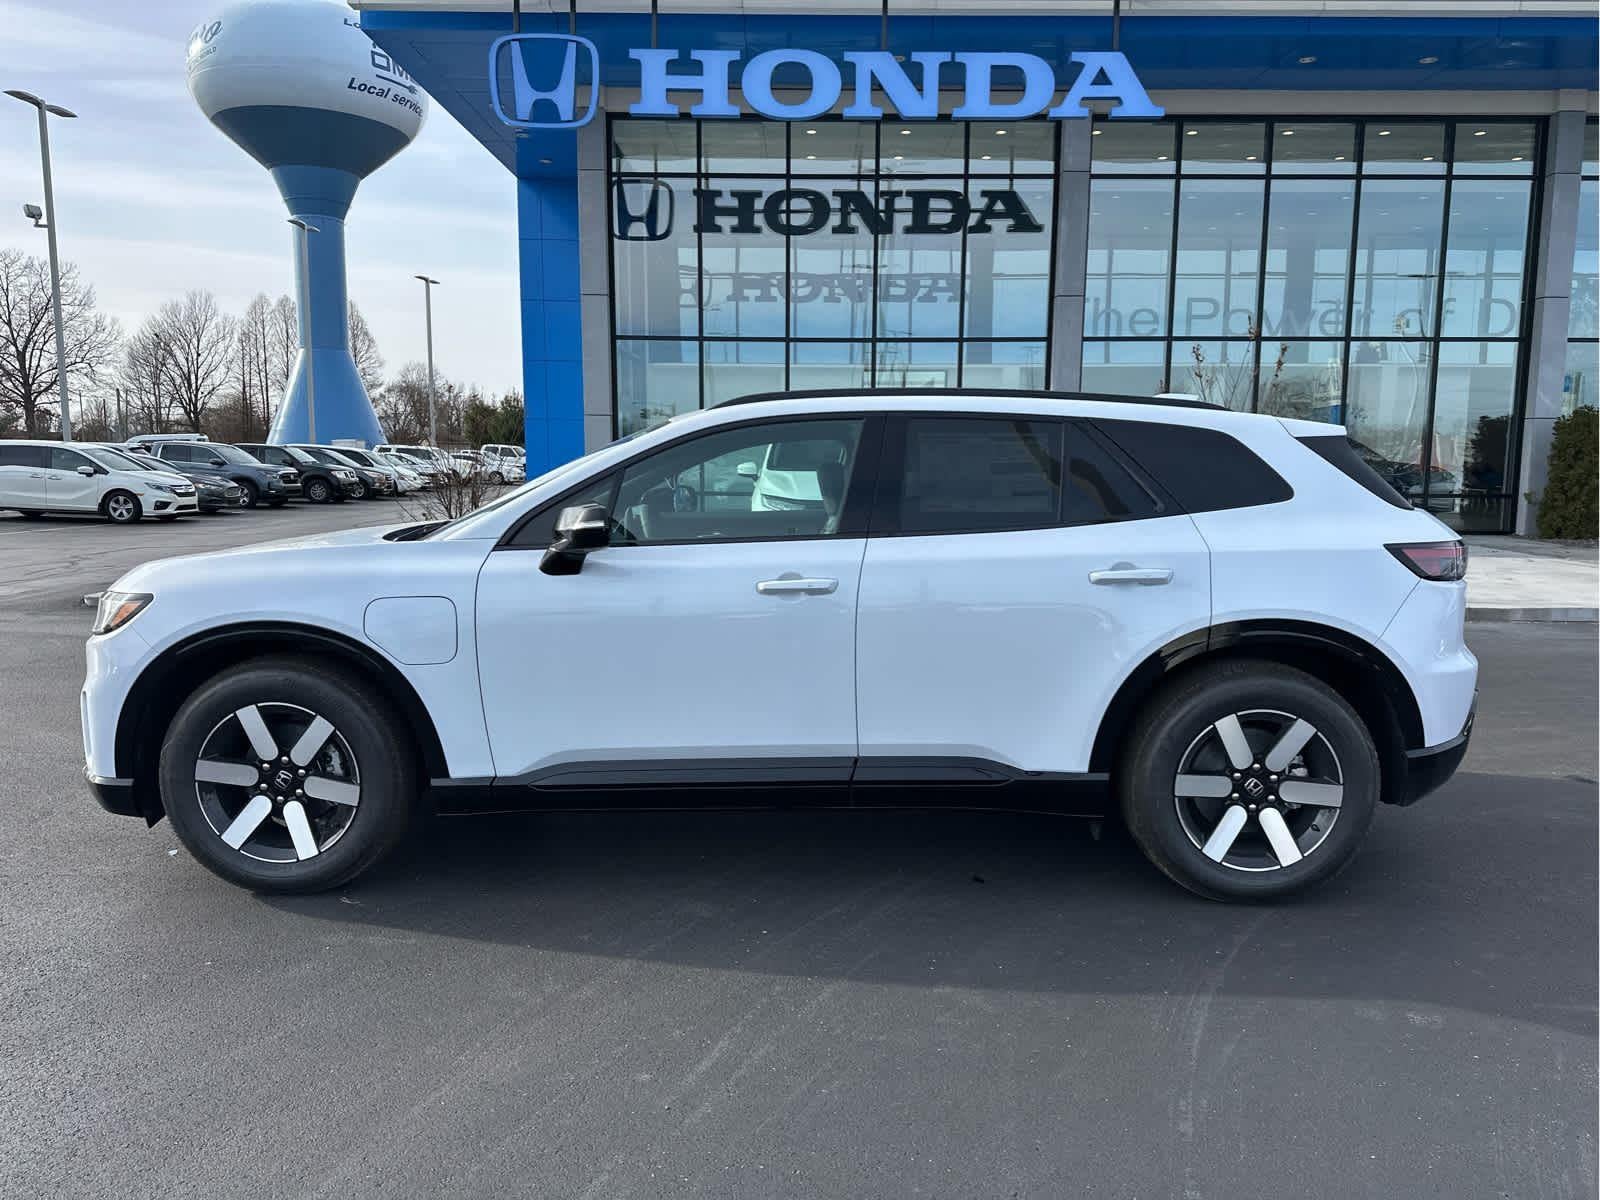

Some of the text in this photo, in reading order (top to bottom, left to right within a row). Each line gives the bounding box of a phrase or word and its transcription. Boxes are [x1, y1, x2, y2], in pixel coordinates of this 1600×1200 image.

[347, 77, 391, 99] Local
[628, 48, 1166, 120] HONDA
[692, 188, 1045, 236] HONDA
[1185, 297, 1373, 337] Power
